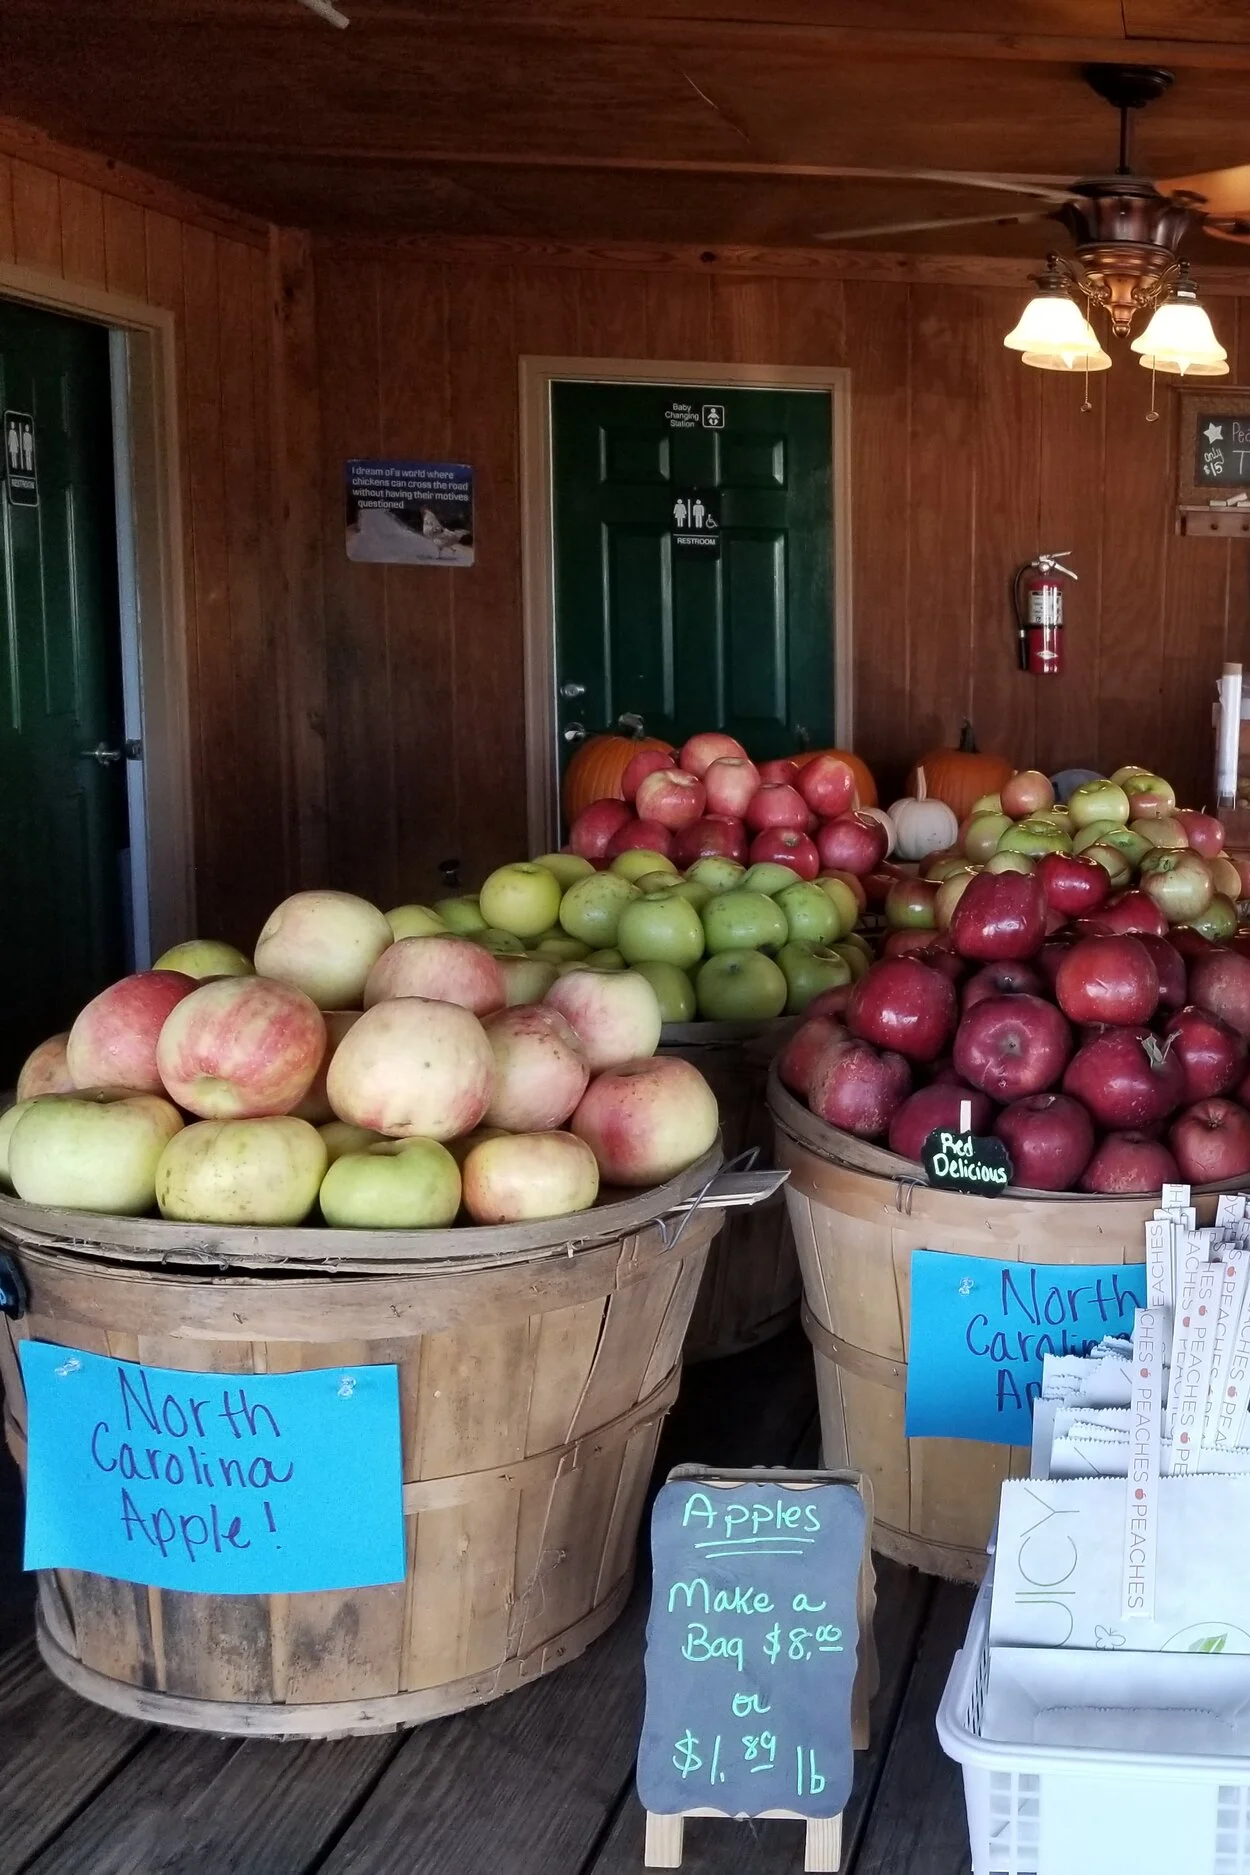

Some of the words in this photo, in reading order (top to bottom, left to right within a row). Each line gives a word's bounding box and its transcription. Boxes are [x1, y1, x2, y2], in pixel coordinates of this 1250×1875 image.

[664, 411, 700, 421] Changing
[670, 420, 695, 428] Station
[672, 403, 692, 412] Baby
[352, 477, 390, 487] chickens
[391, 480, 407, 488] can
[407, 481, 432, 489] cross
[433, 481, 447, 490] the
[448, 482, 468, 491] road
[355, 467, 384, 476] dream
[385, 468, 395, 477] of
[401, 469, 426, 479] world
[427, 470, 454, 479] where
[1203, 461, 1224, 477] $15
[352, 488, 384, 497] without
[385, 489, 413, 500] having
[413, 491, 434, 500] their
[435, 492, 469, 501] motives
[357, 500, 405, 509] questioned
[677, 537, 716, 546] RESTROOM
[941, 1132, 974, 1157] Red
[932, 1153, 1008, 1184] Delicious
[1001, 1268, 1142, 1327] North
[1138, 1309, 1155, 1363] CHES
[1180, 1327, 1207, 1426] PEACHES
[117, 1366, 281, 1439] North
[1133, 1388, 1152, 1483] PEACHES
[91, 1421, 294, 1489] Carolina
[120, 1487, 283, 1563] Apple!
[682, 1492, 822, 1538] Apples
[1127, 1504, 1147, 1609] PEACHES
[668, 1578, 775, 1615] Make
[792, 1593, 827, 1614] a
[681, 1622, 744, 1672] Bag
[731, 1692, 772, 1719] or
[796, 1745, 826, 1797] lb
